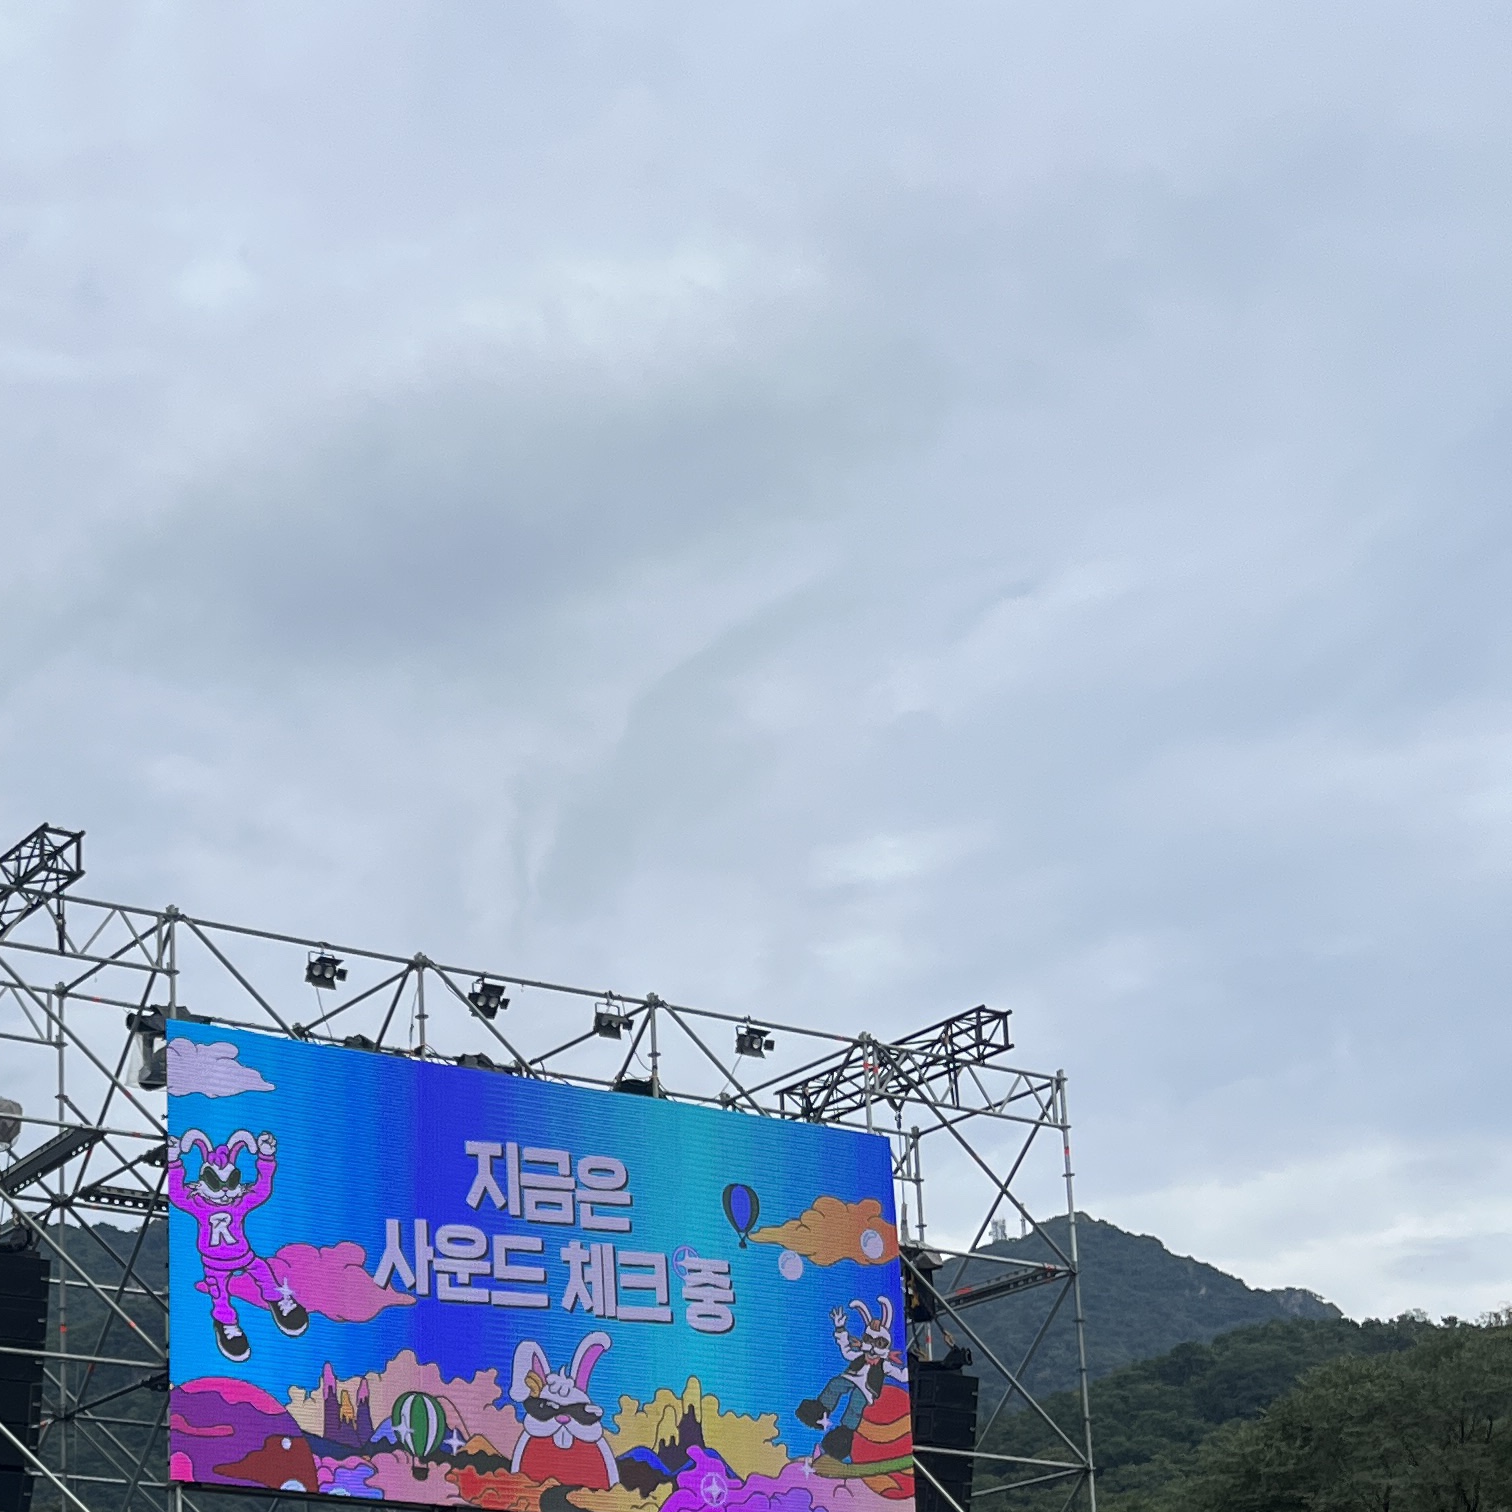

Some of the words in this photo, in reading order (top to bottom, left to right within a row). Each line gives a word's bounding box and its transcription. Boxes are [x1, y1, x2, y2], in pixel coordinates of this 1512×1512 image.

[209, 1212, 238, 1246] R
[465, 1140, 633, 1233] 지금은
[372, 1218, 550, 1308] 사운드
[559, 1240, 673, 1324] 체크
[682, 1256, 736, 1334] 중
